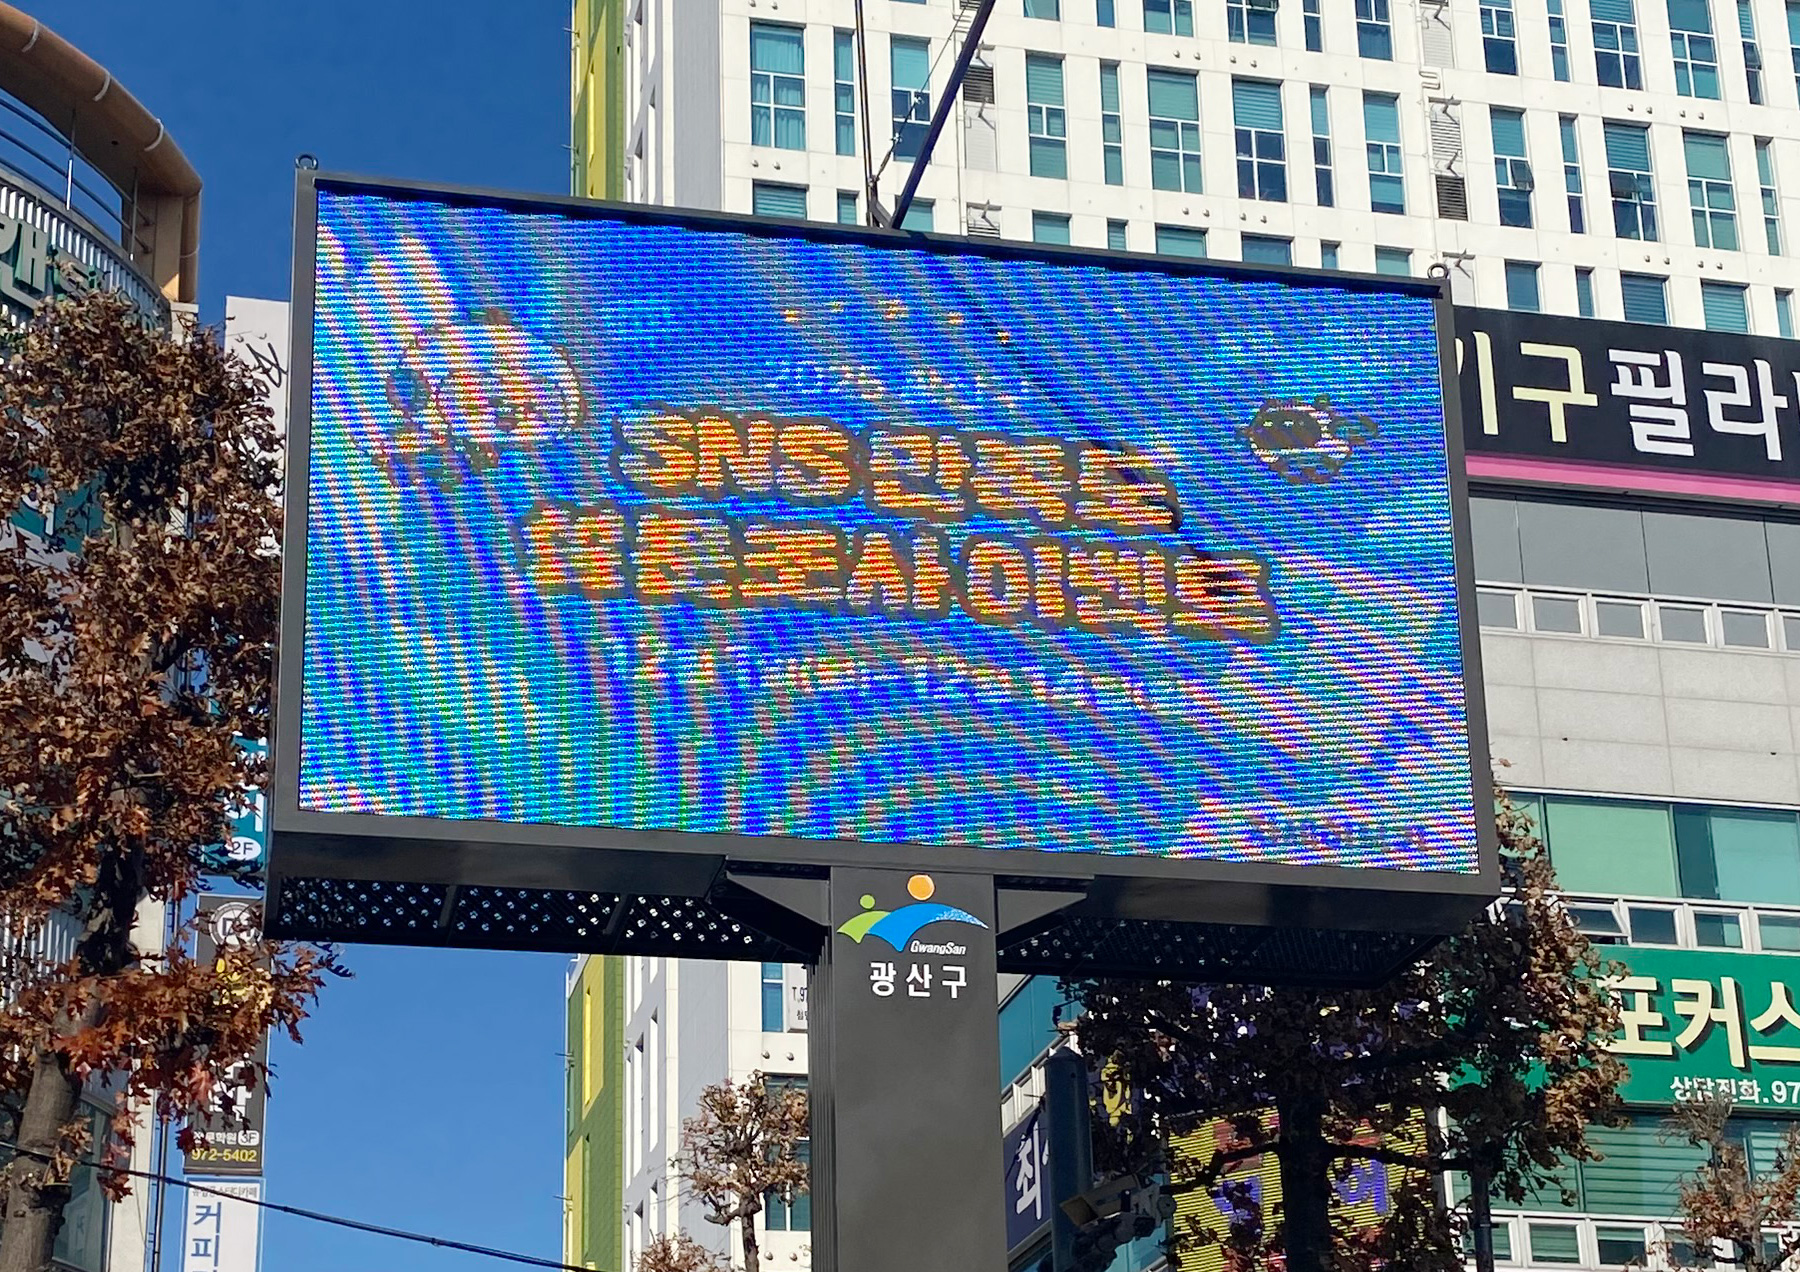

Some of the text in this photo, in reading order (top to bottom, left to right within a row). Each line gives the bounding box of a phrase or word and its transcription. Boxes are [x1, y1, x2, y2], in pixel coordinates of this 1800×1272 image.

[1455, 331, 1800, 462] 구 필라
[617, 408, 1182, 530] SNS 만족도
[965, 536, 1274, 638] 이벤트
[870, 962, 967, 999] 광산구
[911, 940, 966, 955] GwangSan
[191, 1148, 257, 1162] 972-5402
